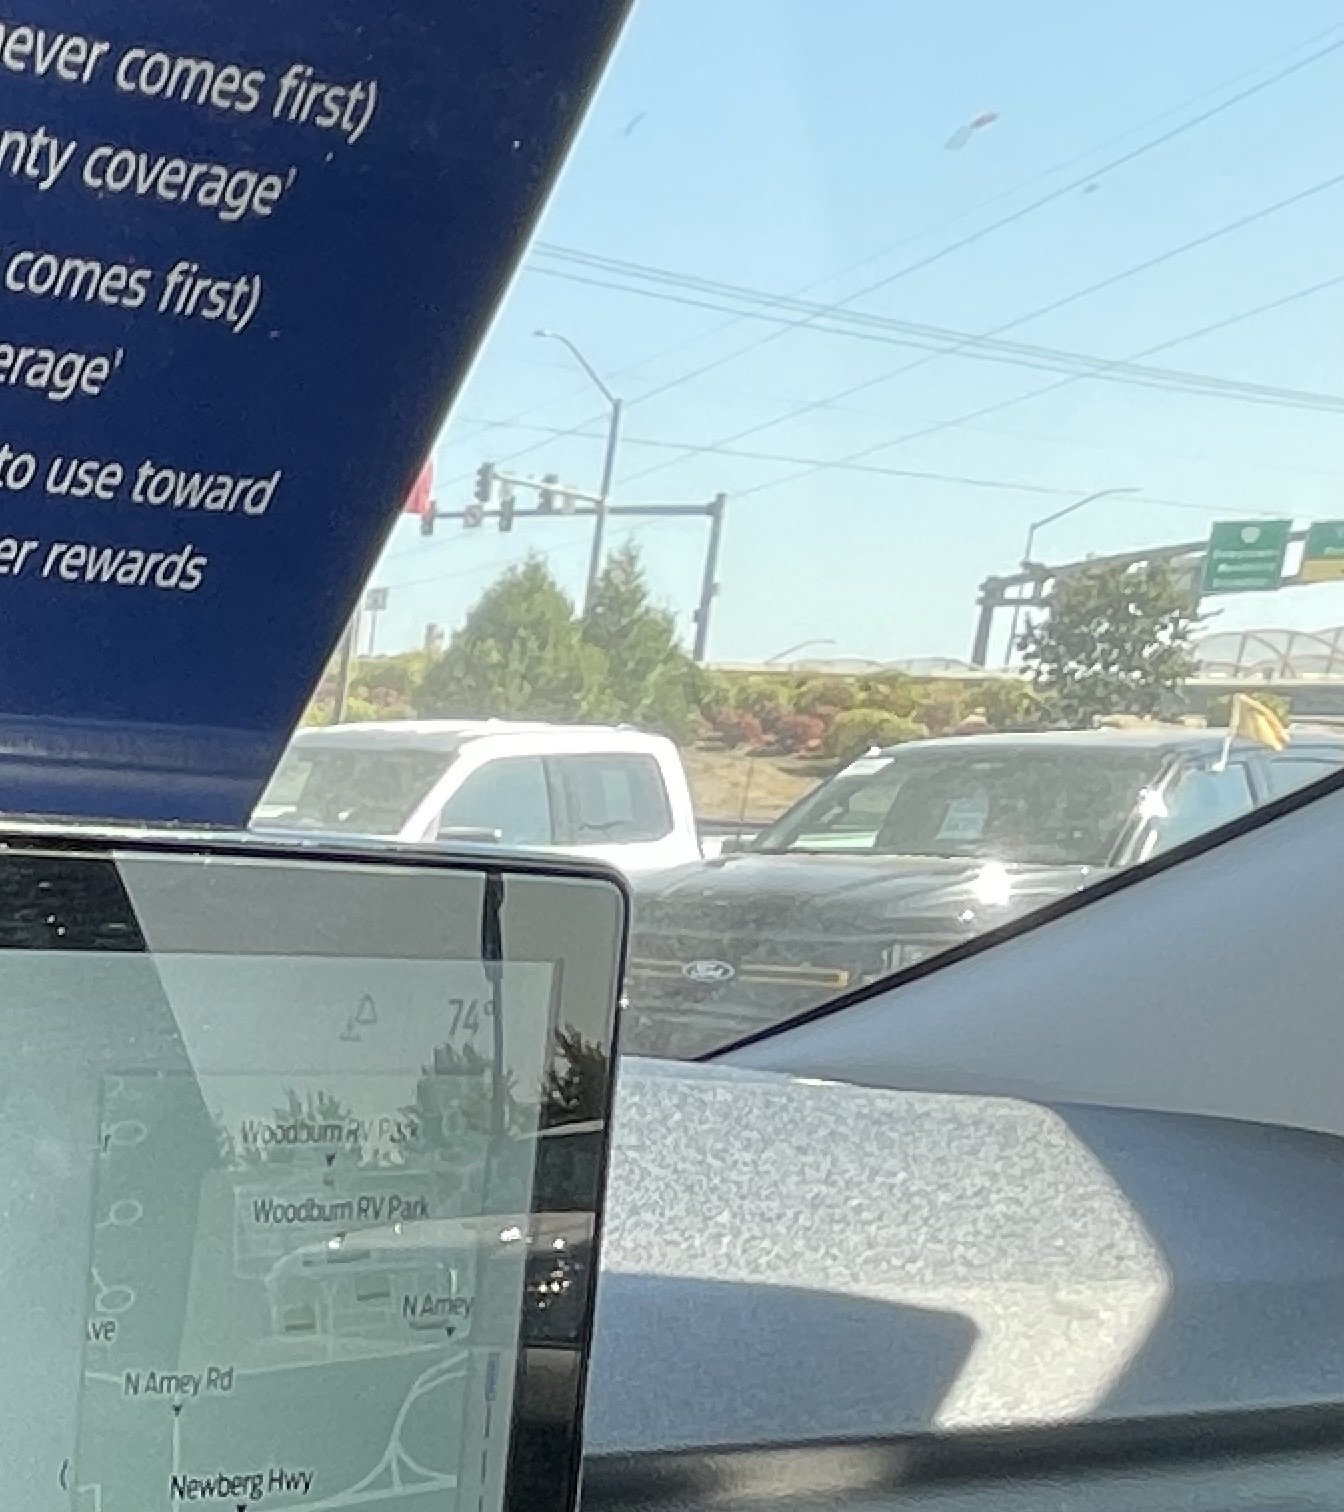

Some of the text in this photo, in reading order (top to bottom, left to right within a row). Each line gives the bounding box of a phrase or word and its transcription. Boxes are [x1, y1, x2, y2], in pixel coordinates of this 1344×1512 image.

[116, 46, 263, 114] comes
[272, 65, 378, 144] first)
[5, 250, 147, 310] comes
[158, 262, 261, 332] first)
[47, 456, 121, 500] use
[132, 460, 279, 516] toward
[42, 544, 205, 591] rewards
[125, 1372, 139, 1394] N
[207, 1366, 233, 1391] Rd
[170, 1468, 312, 1499] Newberg Hwy
